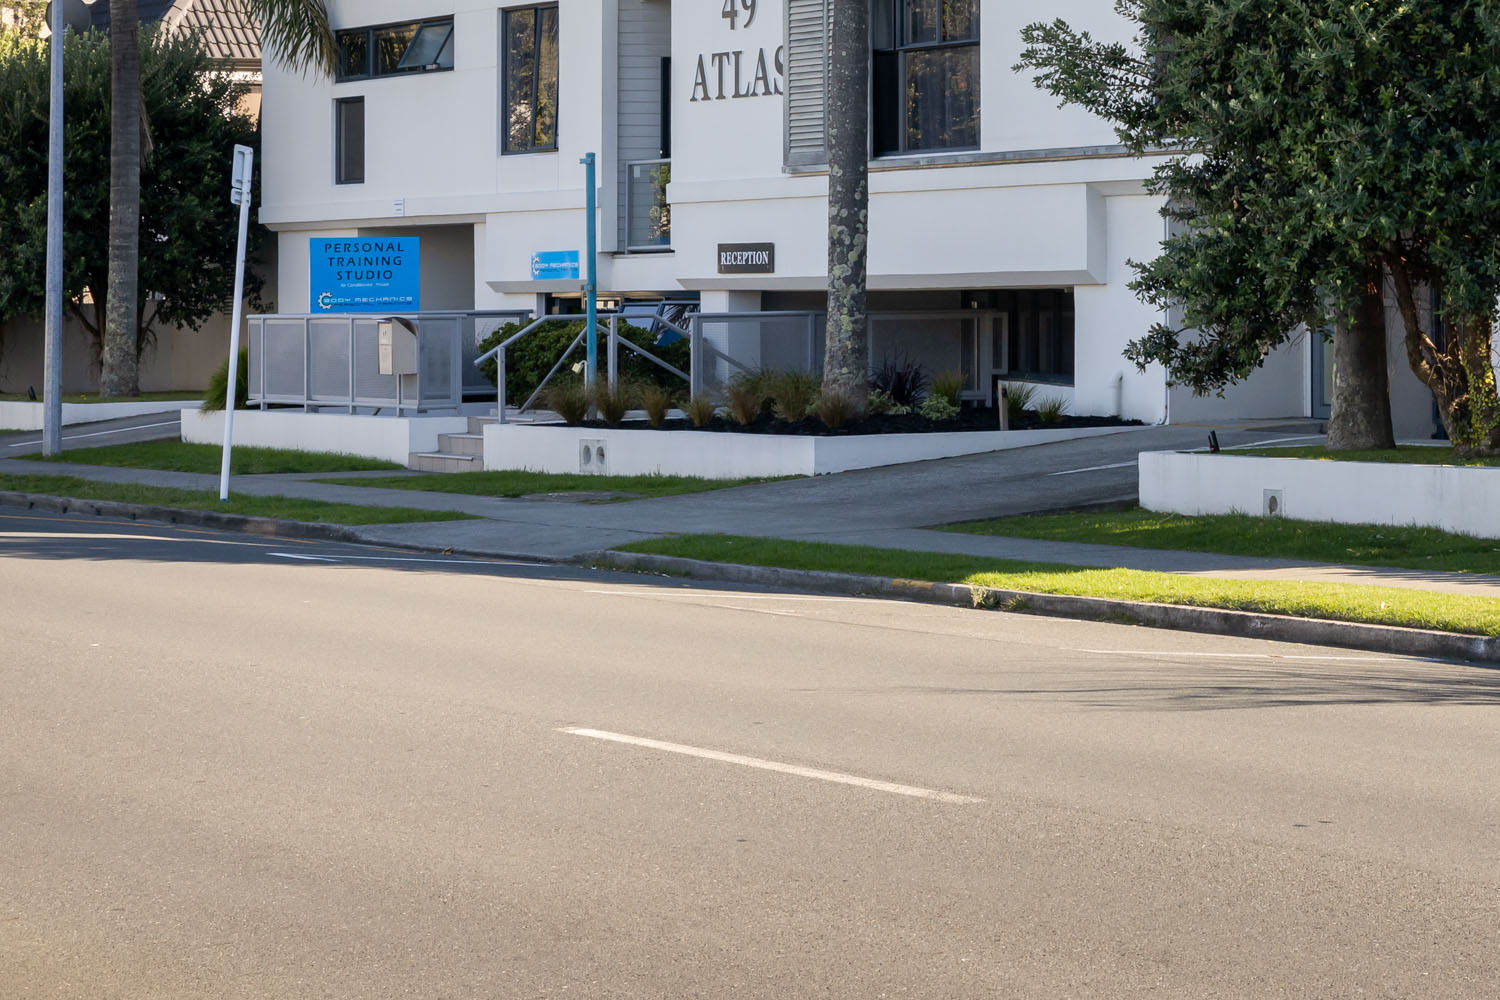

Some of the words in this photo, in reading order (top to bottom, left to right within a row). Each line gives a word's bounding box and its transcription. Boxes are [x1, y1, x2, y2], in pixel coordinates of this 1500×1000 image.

[324, 242, 405, 253] PERSONAL
[327, 256, 402, 267] TRAINING
[720, 250, 769, 265] RECEPTION
[336, 270, 393, 280] STUDIO
